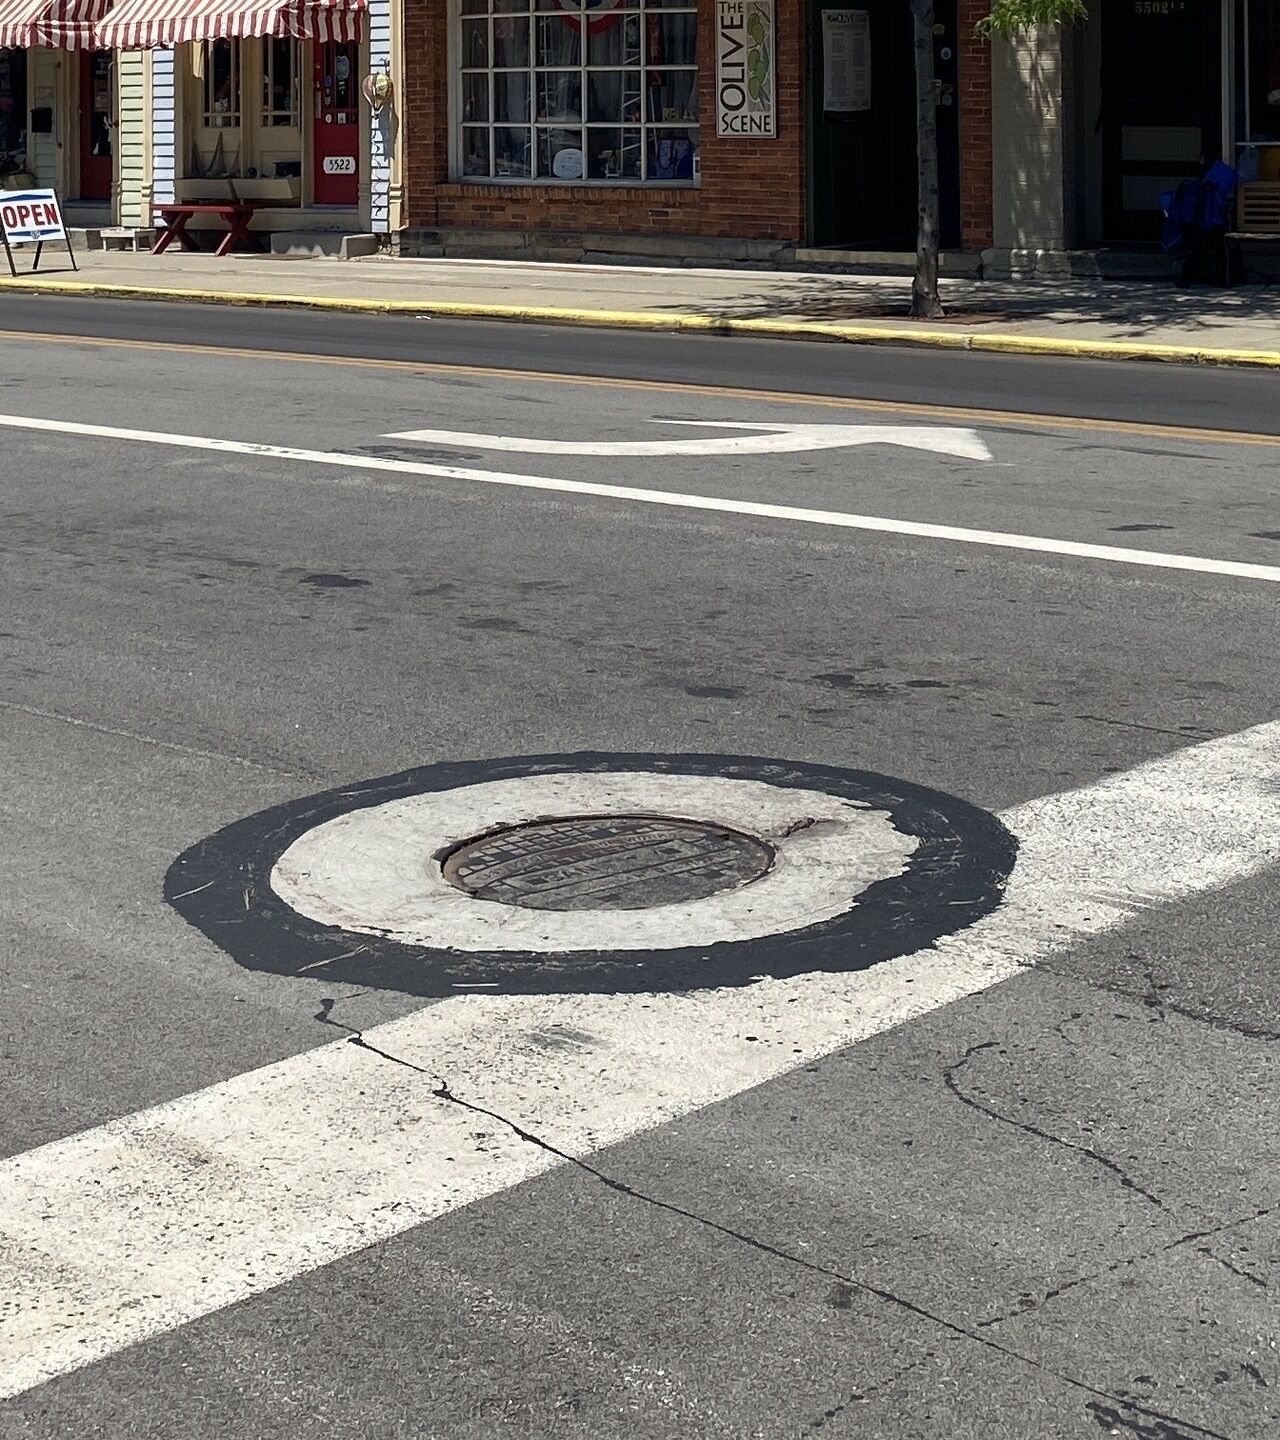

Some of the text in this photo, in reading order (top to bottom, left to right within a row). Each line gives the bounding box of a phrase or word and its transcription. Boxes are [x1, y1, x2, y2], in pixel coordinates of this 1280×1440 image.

[718, 1, 744, 14] THE
[1135, 1, 1169, 15] 5502
[720, 14, 746, 112] OLIVE
[721, 112, 772, 133] SCENE
[328, 158, 351, 171] 5522
[2, 203, 60, 229] OPEN
